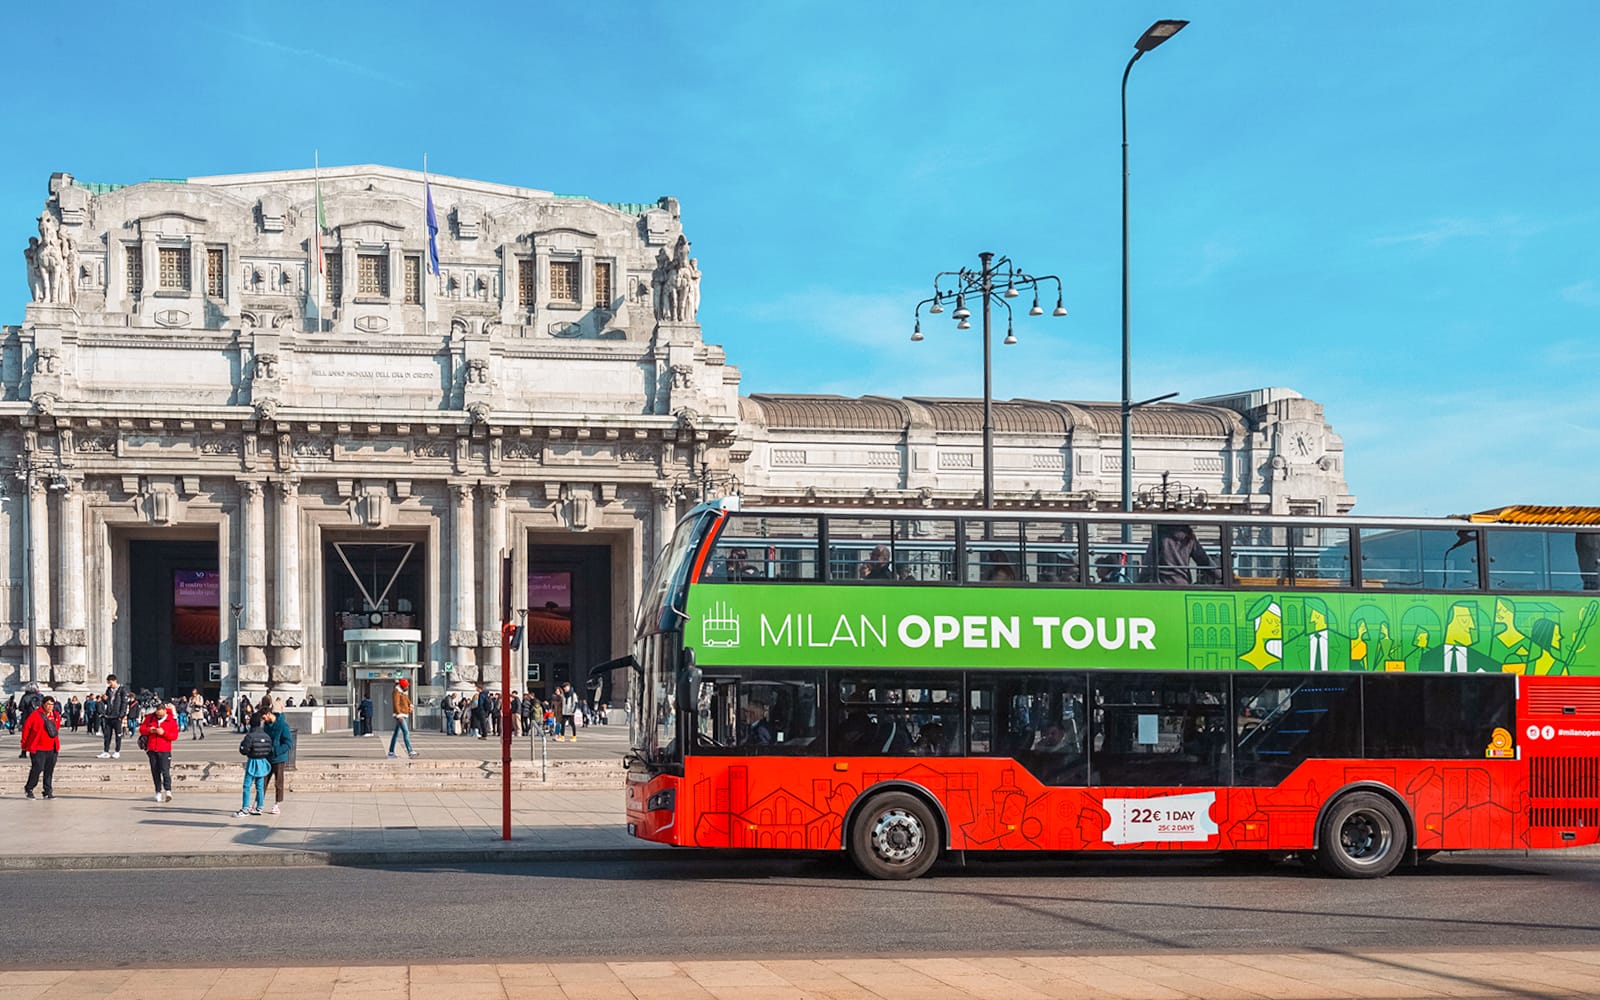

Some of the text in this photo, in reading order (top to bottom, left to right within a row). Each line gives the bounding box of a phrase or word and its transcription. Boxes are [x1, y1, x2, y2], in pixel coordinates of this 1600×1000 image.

[760, 613, 1157, 650] MILAN OPEN TOUR
[1131, 808, 1195, 823] 22€ 1 DAY
